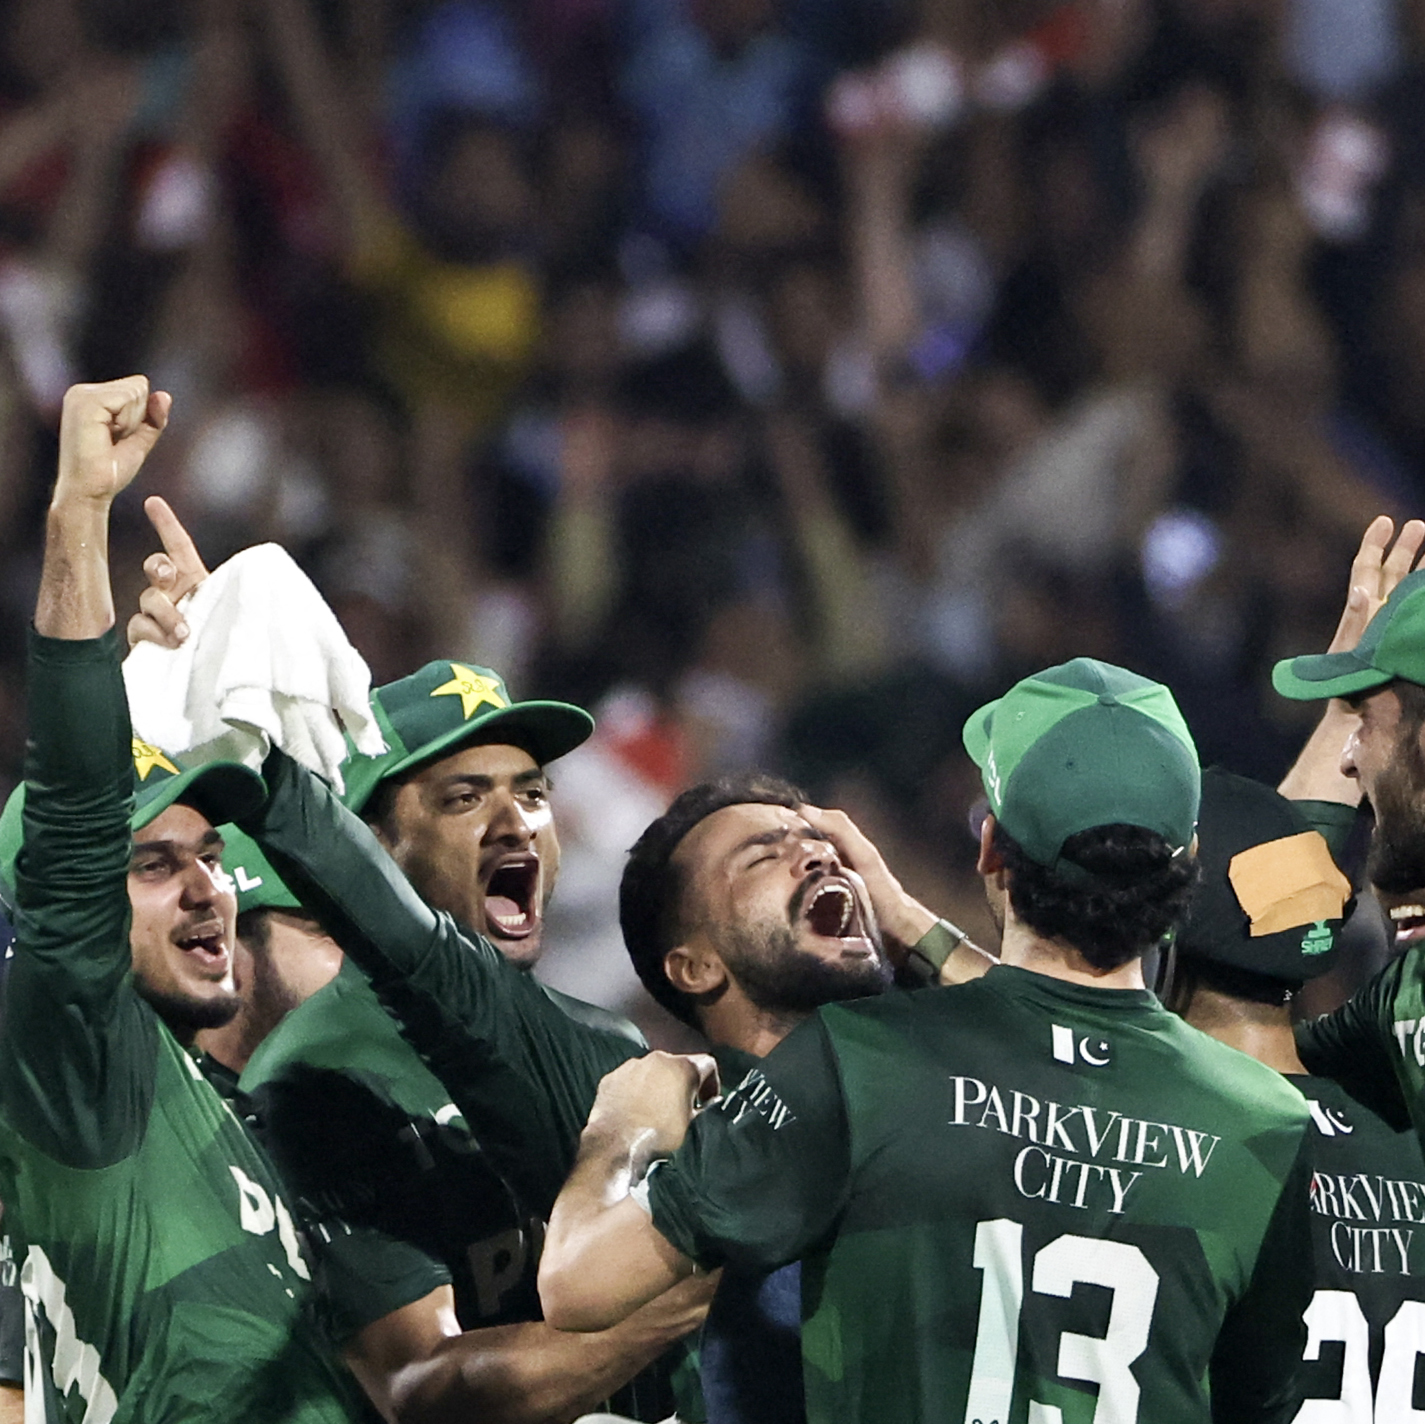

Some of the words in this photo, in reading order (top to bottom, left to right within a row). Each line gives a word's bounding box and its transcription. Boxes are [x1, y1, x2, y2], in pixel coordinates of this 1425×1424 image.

[948, 1075, 1222, 1179] PARKVIEW
[1013, 1145, 1143, 1215] CITY
[1330, 1220, 1414, 1277] CITY
